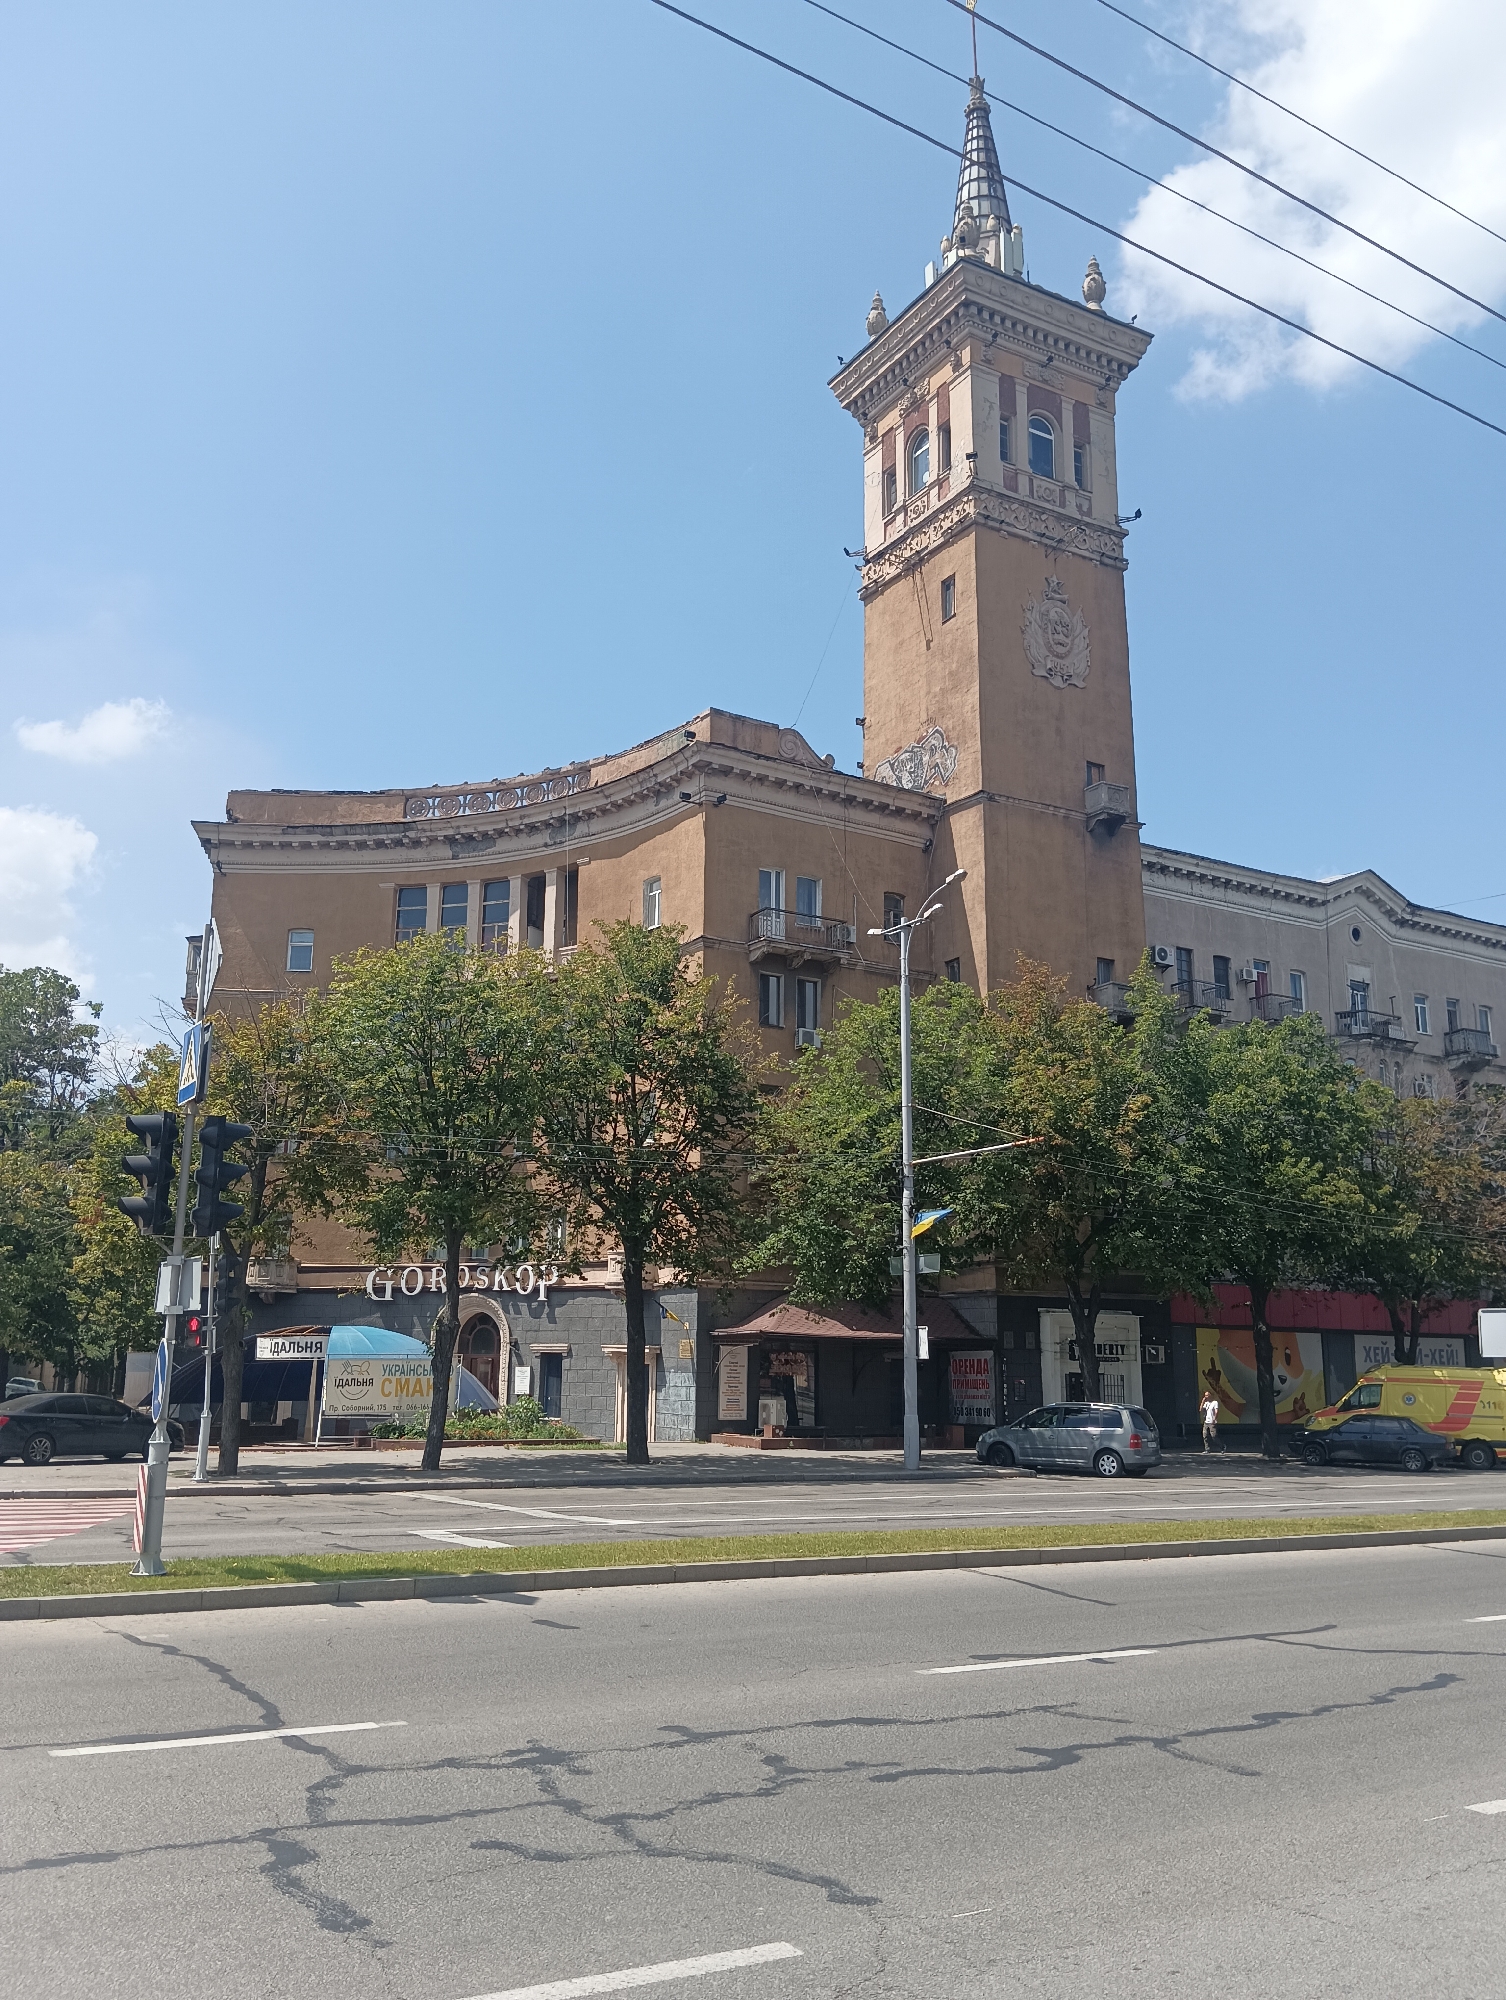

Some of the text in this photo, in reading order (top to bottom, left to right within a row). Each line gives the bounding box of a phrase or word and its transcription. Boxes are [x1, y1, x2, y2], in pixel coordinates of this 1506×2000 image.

[365, 1266, 559, 1300] GOROSKOP
[270, 1338, 322, 1356] ЇДАЛЬНЯ
[1363, 1341, 1459, 1365] ХЕЙ-Й-ХЕЙ!
[952, 1358, 989, 1376] ОРЕНДА
[334, 1376, 374, 1388] ЇДАЛЬНЯ
[380, 1378, 452, 1397] СМАК
[952, 1379, 990, 1391] ПРИМІЩЕНЬ
[341, 1404, 375, 1413] Соборний,
[376, 1403, 387, 1411] 175
